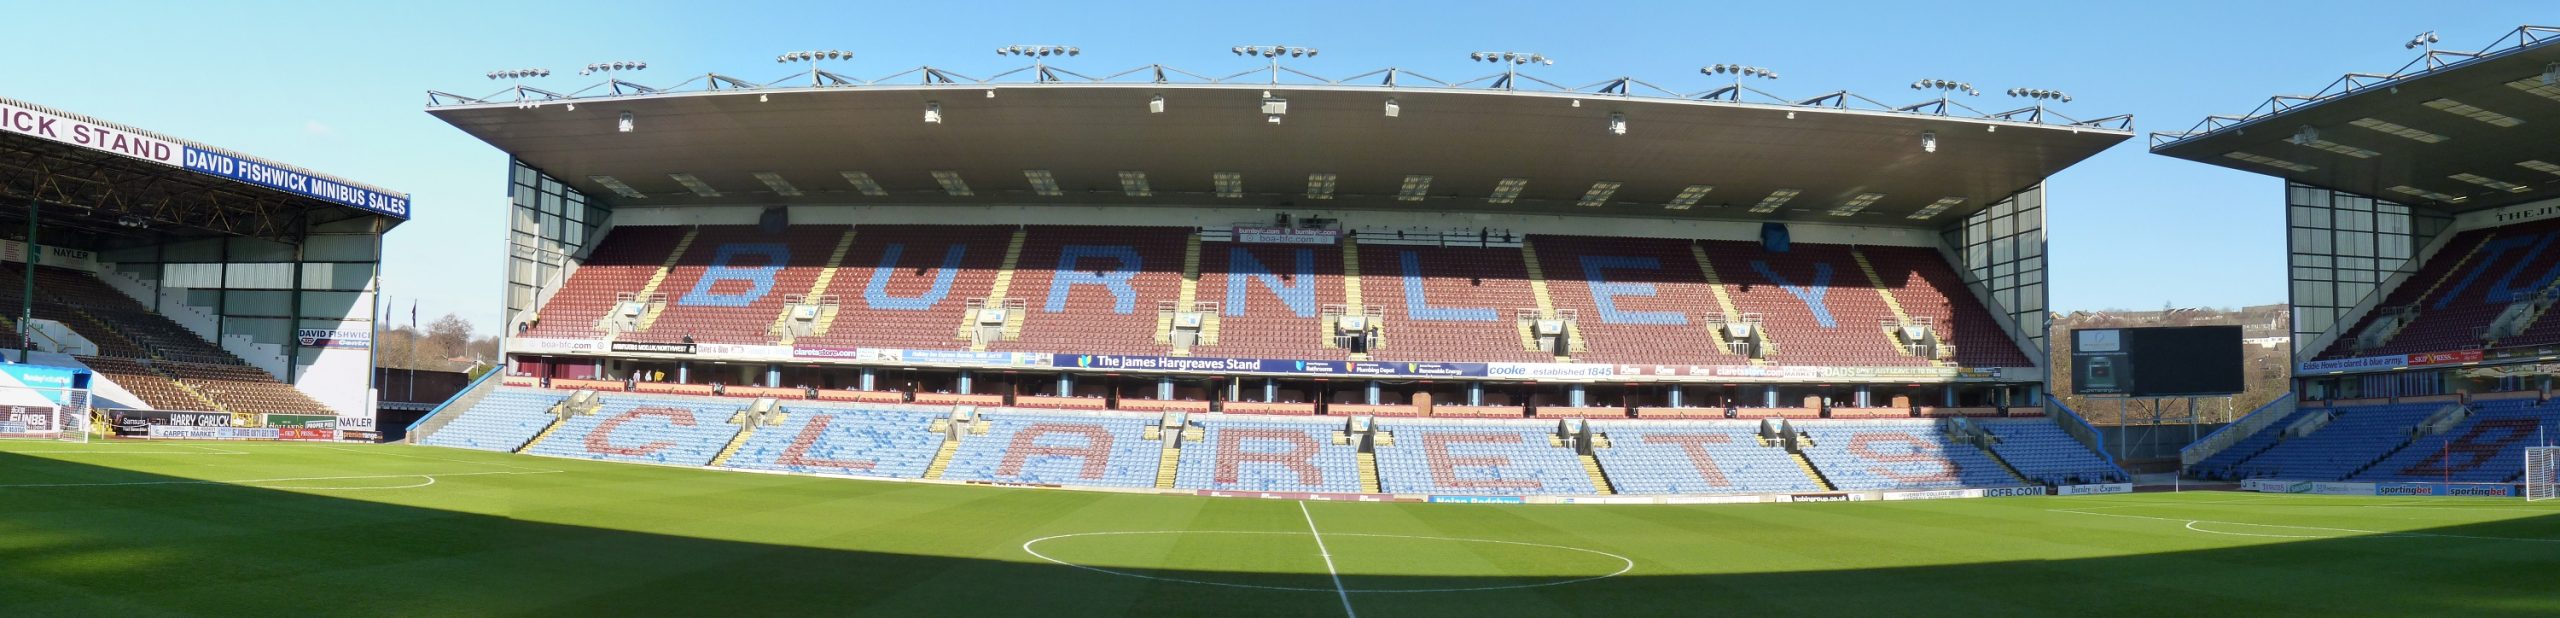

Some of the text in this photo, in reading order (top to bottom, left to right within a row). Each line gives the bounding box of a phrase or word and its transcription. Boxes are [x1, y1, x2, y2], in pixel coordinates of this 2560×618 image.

[2, 107, 171, 162] ICK STAND
[186, 148, 406, 216] DAVID FISHWICK MINIBUS SALES
[2496, 209, 2534, 221] THE
[1260, 234, 1315, 243] boa-bfc.com
[53, 247, 89, 260] NAYLER
[678, 243, 1839, 330] BURNLEY
[299, 329, 327, 338] DAVID
[540, 341, 592, 350] boa-bfc.com
[793, 347, 856, 358] claretsstore.com
[1097, 355, 1260, 370] The James Hargreaves Stand
[2303, 361, 2320, 371] Eddie
[2321, 360, 2343, 370] Howe's
[2344, 359, 2361, 368] claret
[2370, 357, 2383, 366] blue
[1489, 365, 1526, 375] cooke
[1533, 366, 1585, 376] established
[1587, 367, 1612, 376] 1845
[1825, 367, 1856, 377] DADS
[123, 418, 146, 426] Samsung
[170, 413, 197, 427] HARRY
[198, 414, 230, 428] GARLICK
[339, 417, 372, 428] NAYLER
[163, 430, 189, 438] CARPET
[190, 430, 216, 438] MARKET
[584, 406, 1964, 488] CLARETS
[1982, 486, 2042, 498] UCFB.COM
[2380, 485, 2432, 496] sportingbet
[2449, 486, 2507, 497] sportingbet
[1793, 495, 1847, 503] hobingroup.co.uk
